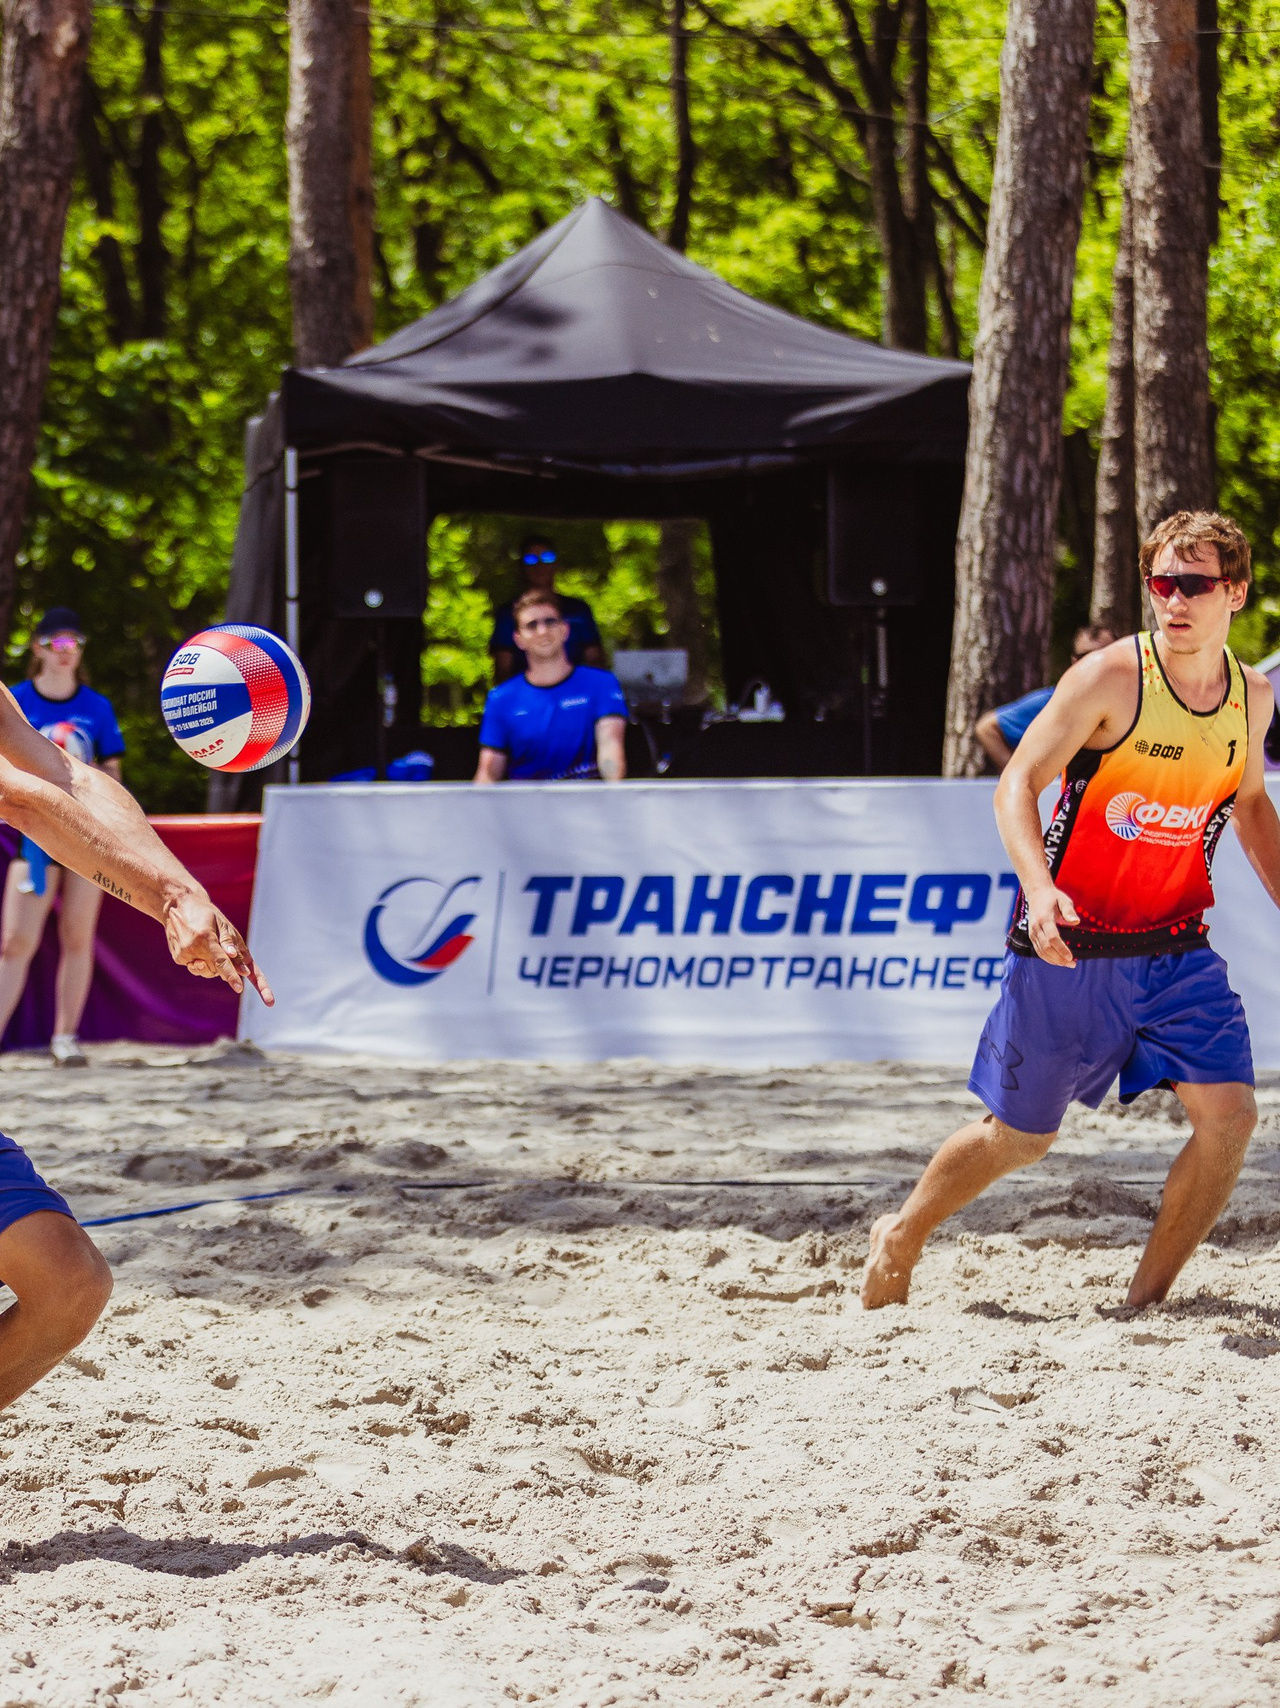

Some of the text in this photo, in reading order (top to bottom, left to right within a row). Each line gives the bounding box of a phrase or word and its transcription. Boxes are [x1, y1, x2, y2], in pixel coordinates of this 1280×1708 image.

[188, 688, 216, 704] РОССИИ
[182, 700, 218, 717] ВОЛЕЙБОЛ
[1148, 743, 1184, 760] ВФВ
[1226, 740, 1237, 767] 1
[518, 956, 1004, 989] ЧЕРНОМОРТРАНСНЕФ
